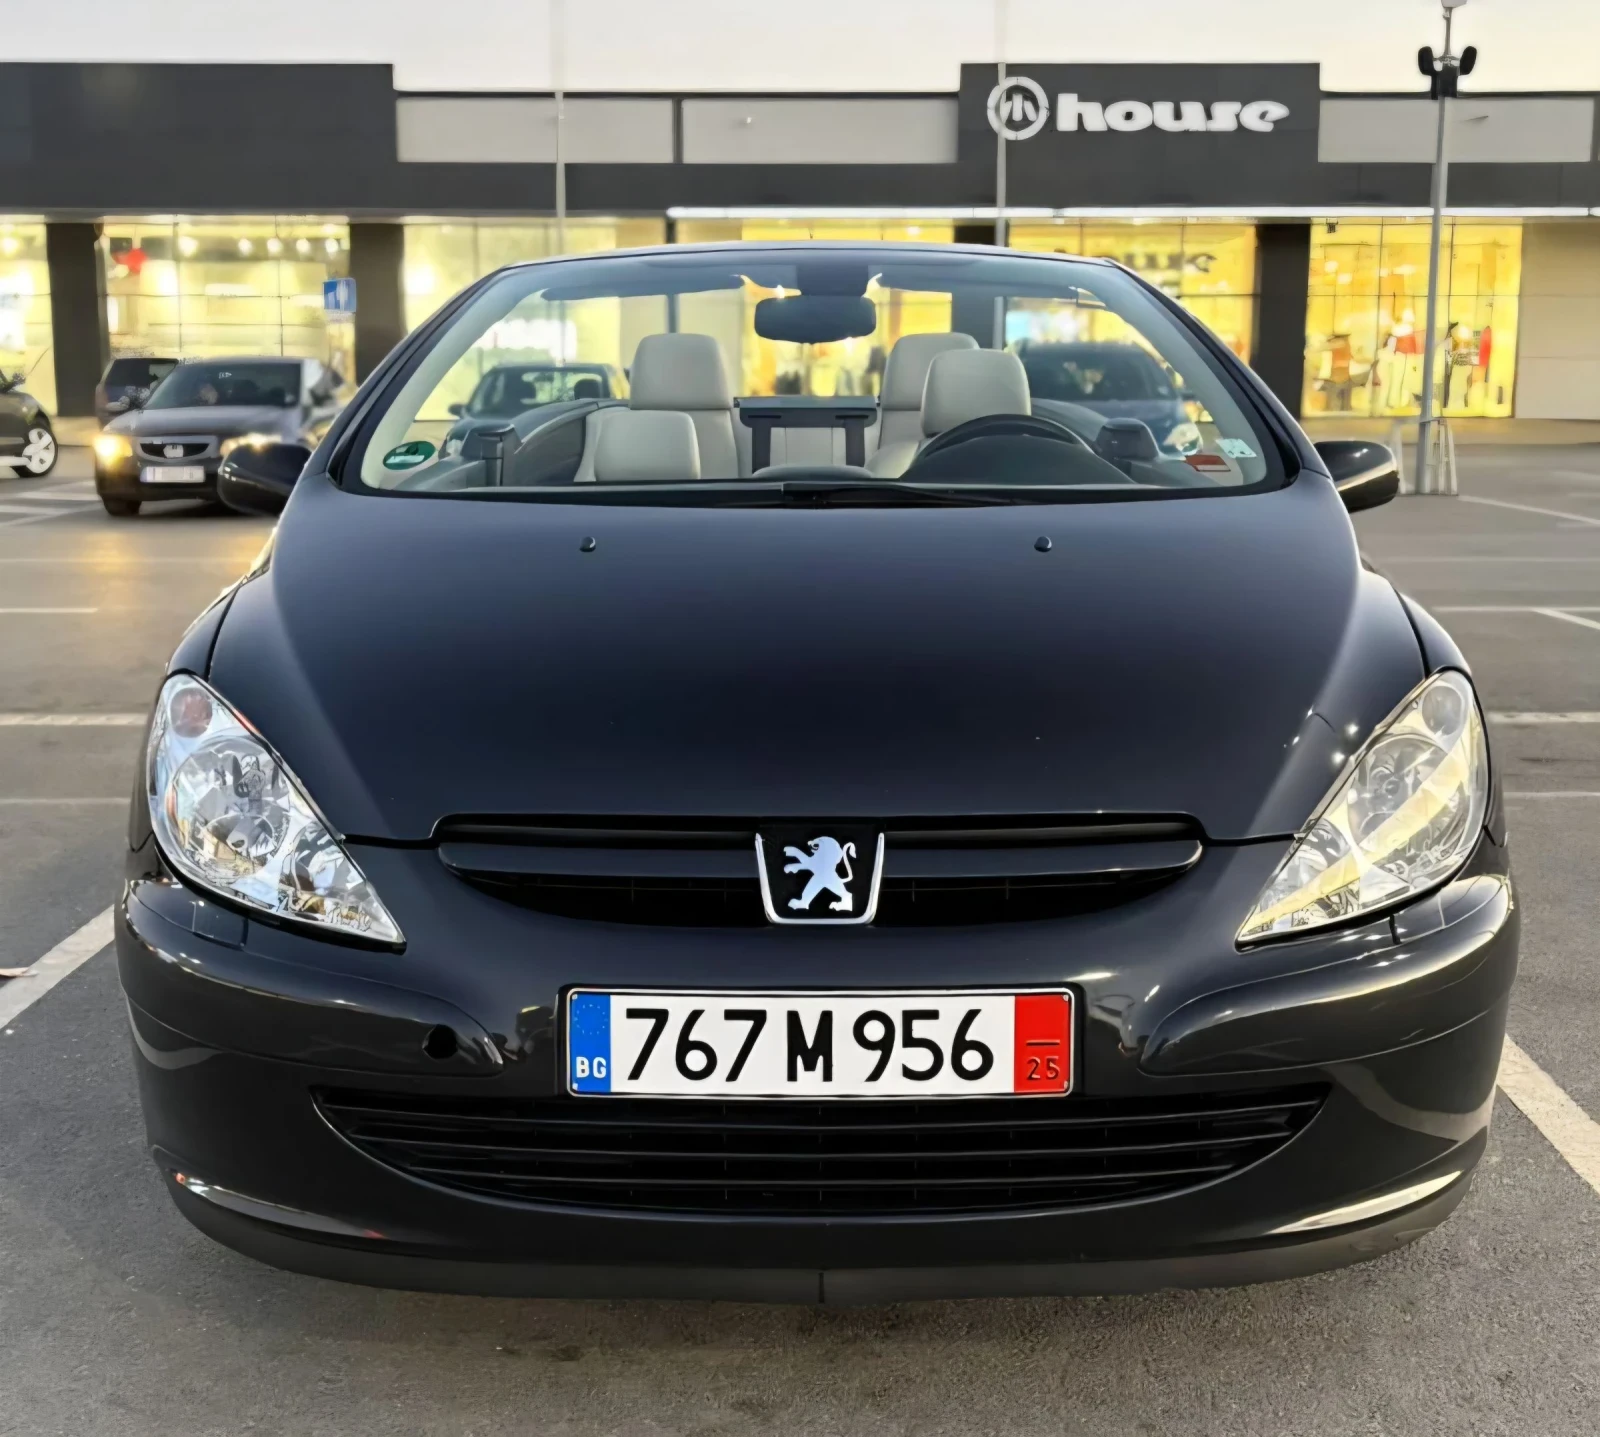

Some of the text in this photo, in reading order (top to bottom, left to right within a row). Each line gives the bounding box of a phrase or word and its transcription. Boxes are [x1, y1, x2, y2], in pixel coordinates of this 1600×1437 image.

[1056, 92, 1290, 133] house
[625, 1007, 994, 1083] 767 M 956
[575, 1056, 608, 1079] BG
[1026, 1058, 1061, 1082] 25
